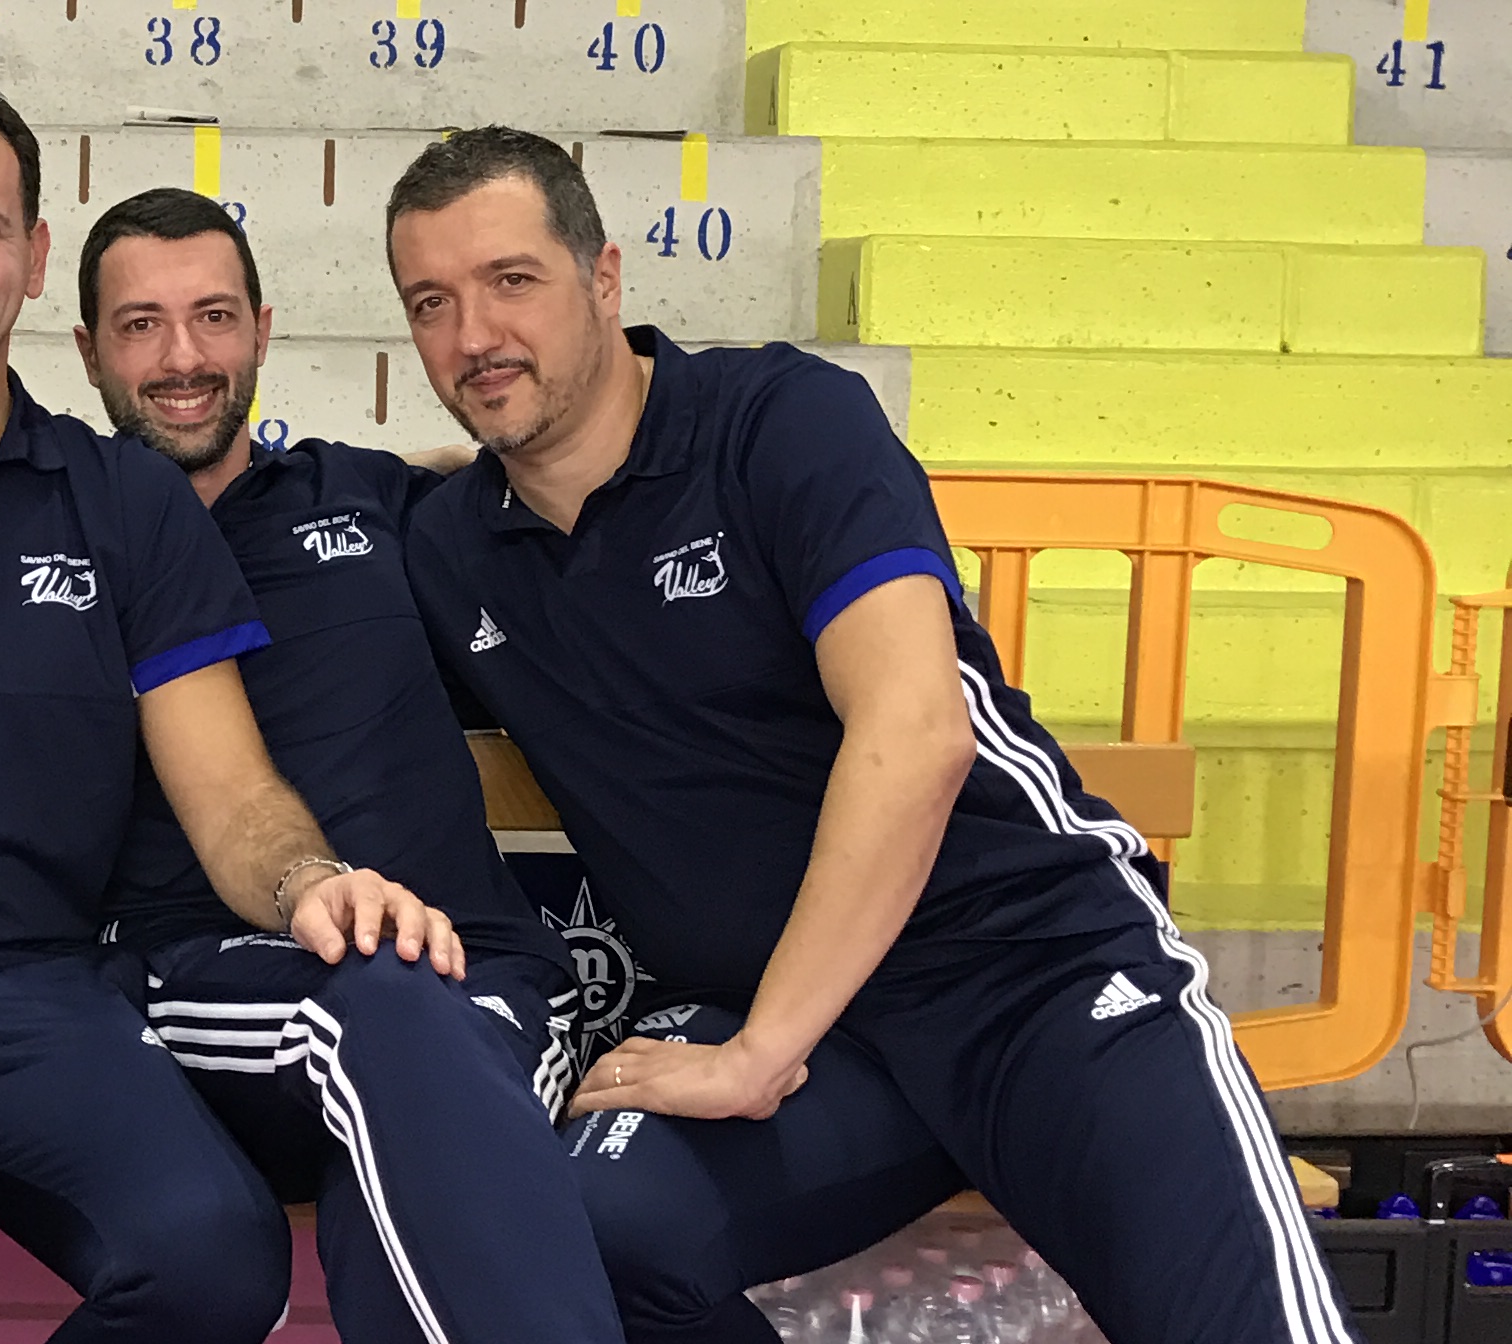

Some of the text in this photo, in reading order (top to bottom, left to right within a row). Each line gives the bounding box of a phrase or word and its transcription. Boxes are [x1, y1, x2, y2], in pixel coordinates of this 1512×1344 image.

[144, 16, 222, 67] 38
[586, 21, 666, 75] 40
[645, 206, 732, 262] 40
